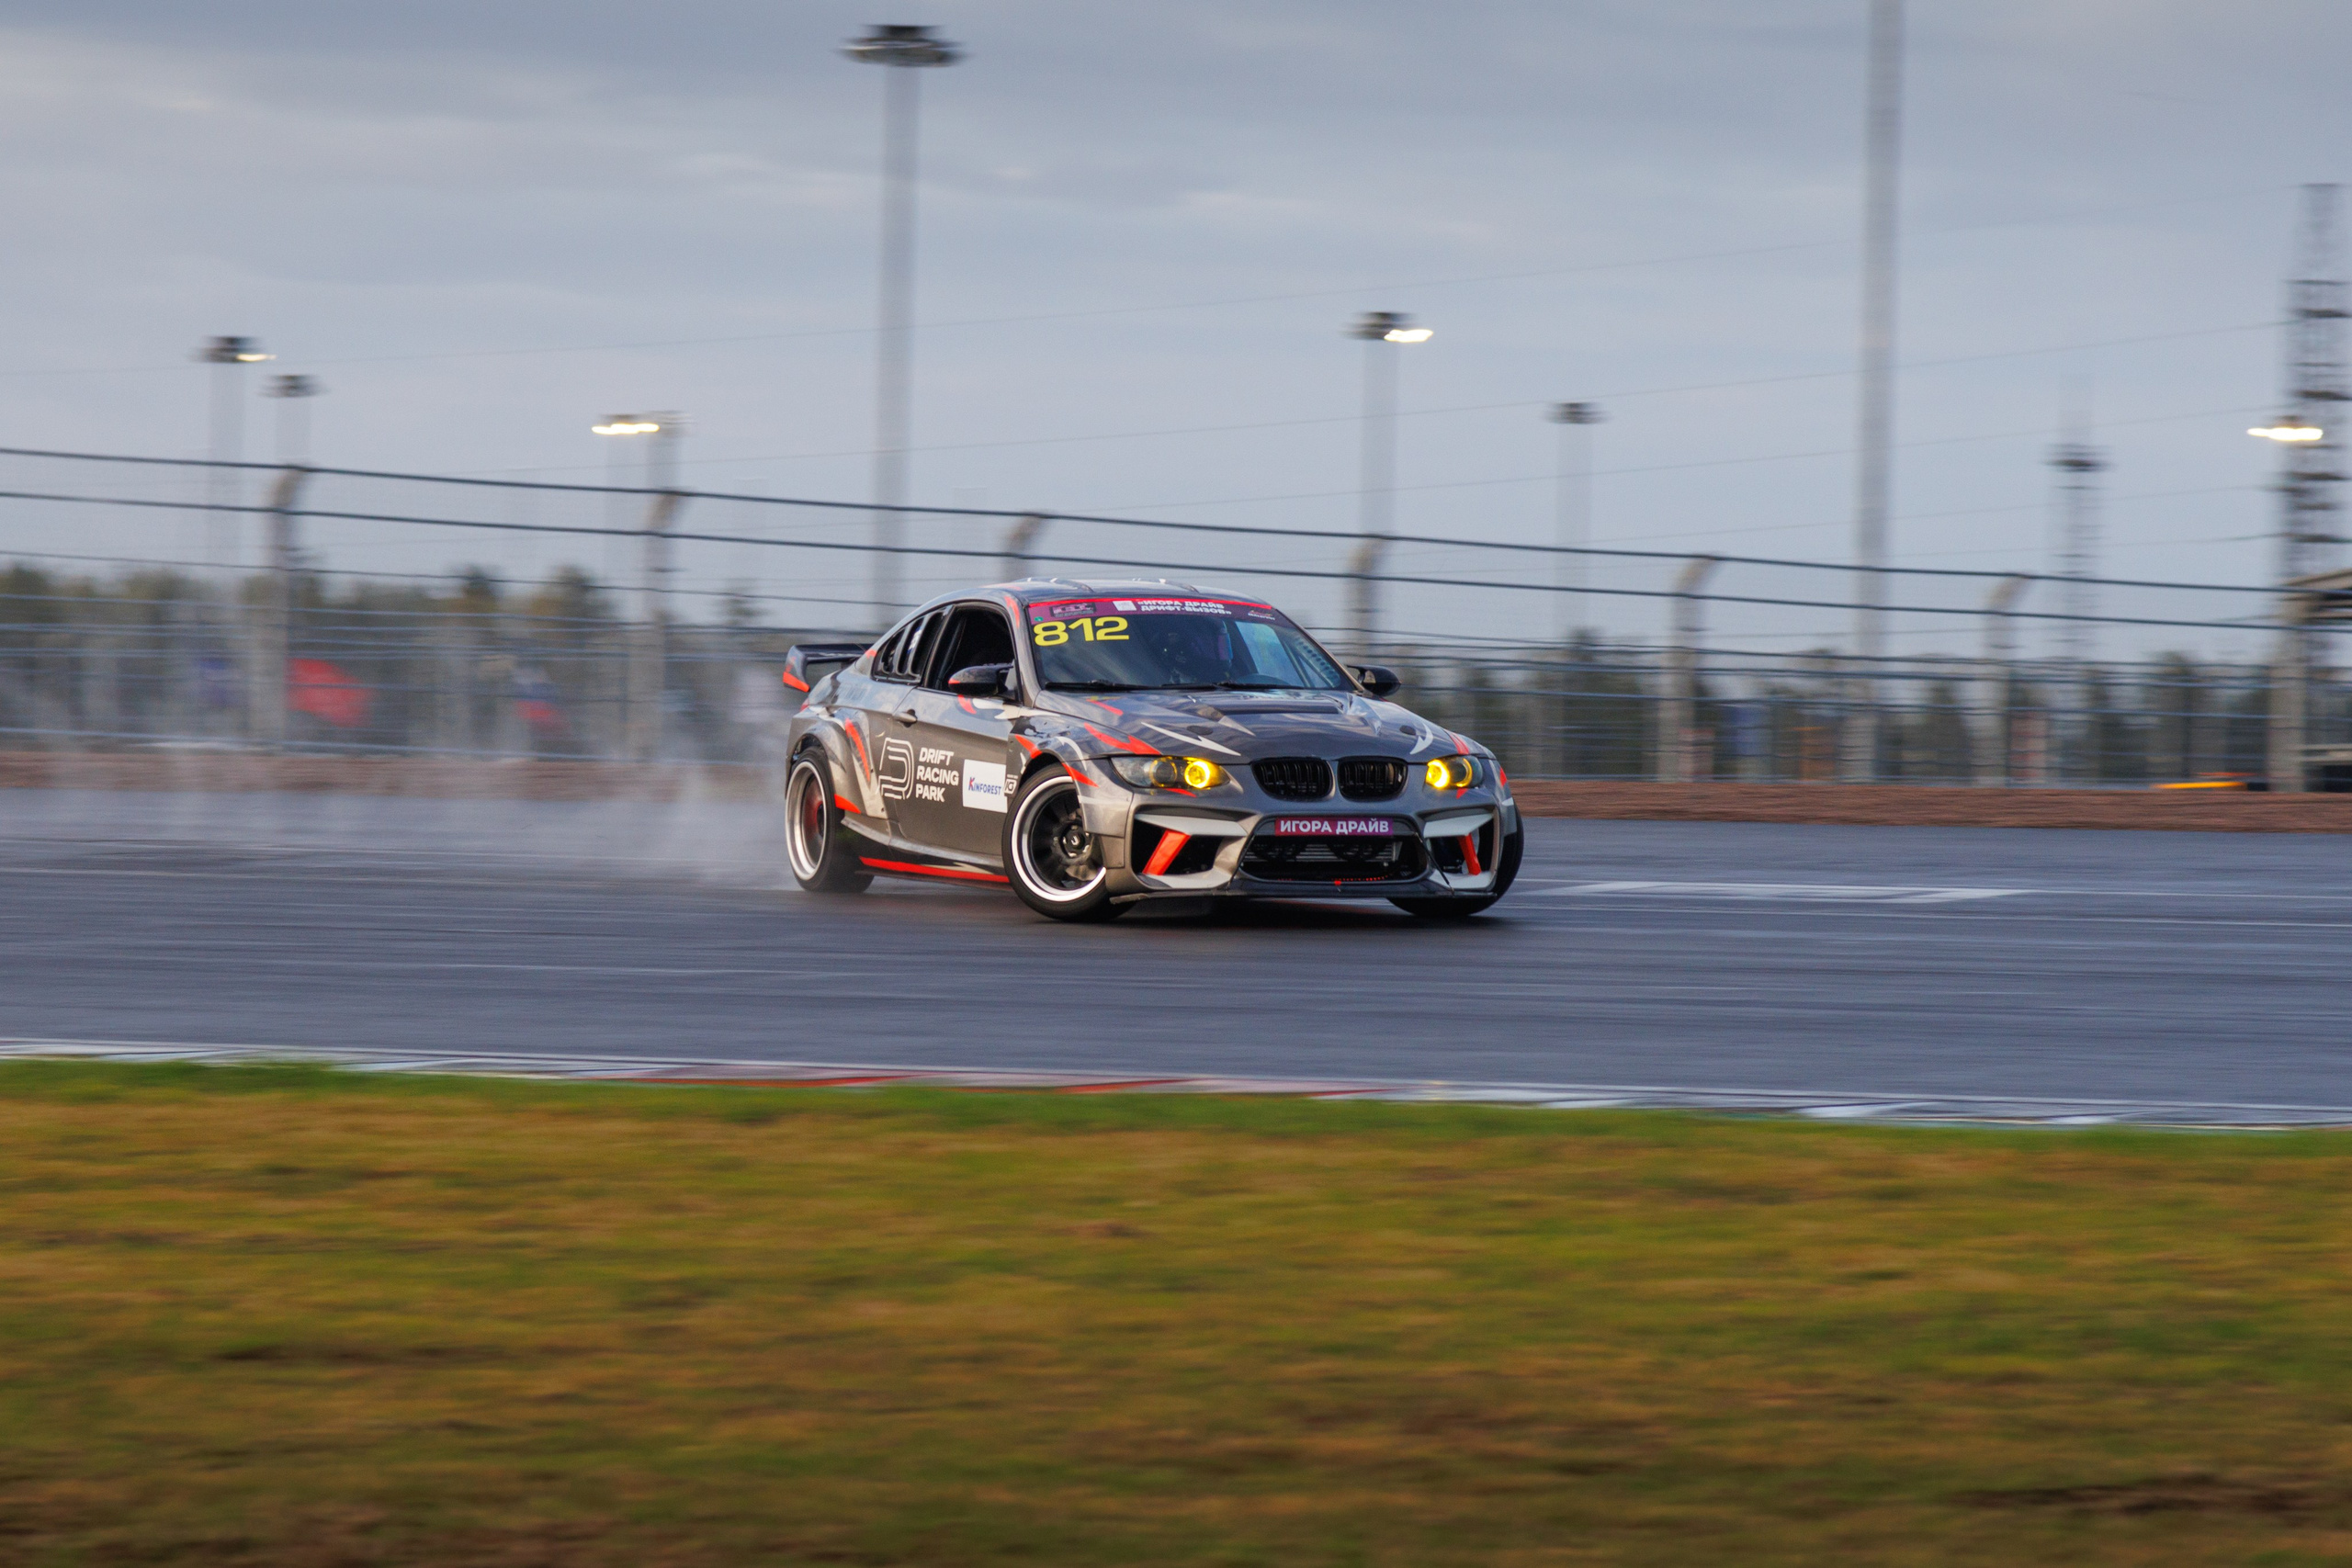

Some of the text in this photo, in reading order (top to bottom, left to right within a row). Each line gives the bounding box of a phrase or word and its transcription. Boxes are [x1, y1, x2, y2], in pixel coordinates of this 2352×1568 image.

[1033, 616, 1130, 646] 812
[919, 747, 955, 766] DRIFT
[916, 765, 960, 786] RACING
[915, 784, 945, 803] PARK
[967, 776, 1002, 795] KINFOREST
[1280, 818, 1389, 835] ИГОРА ДРАЙВ
